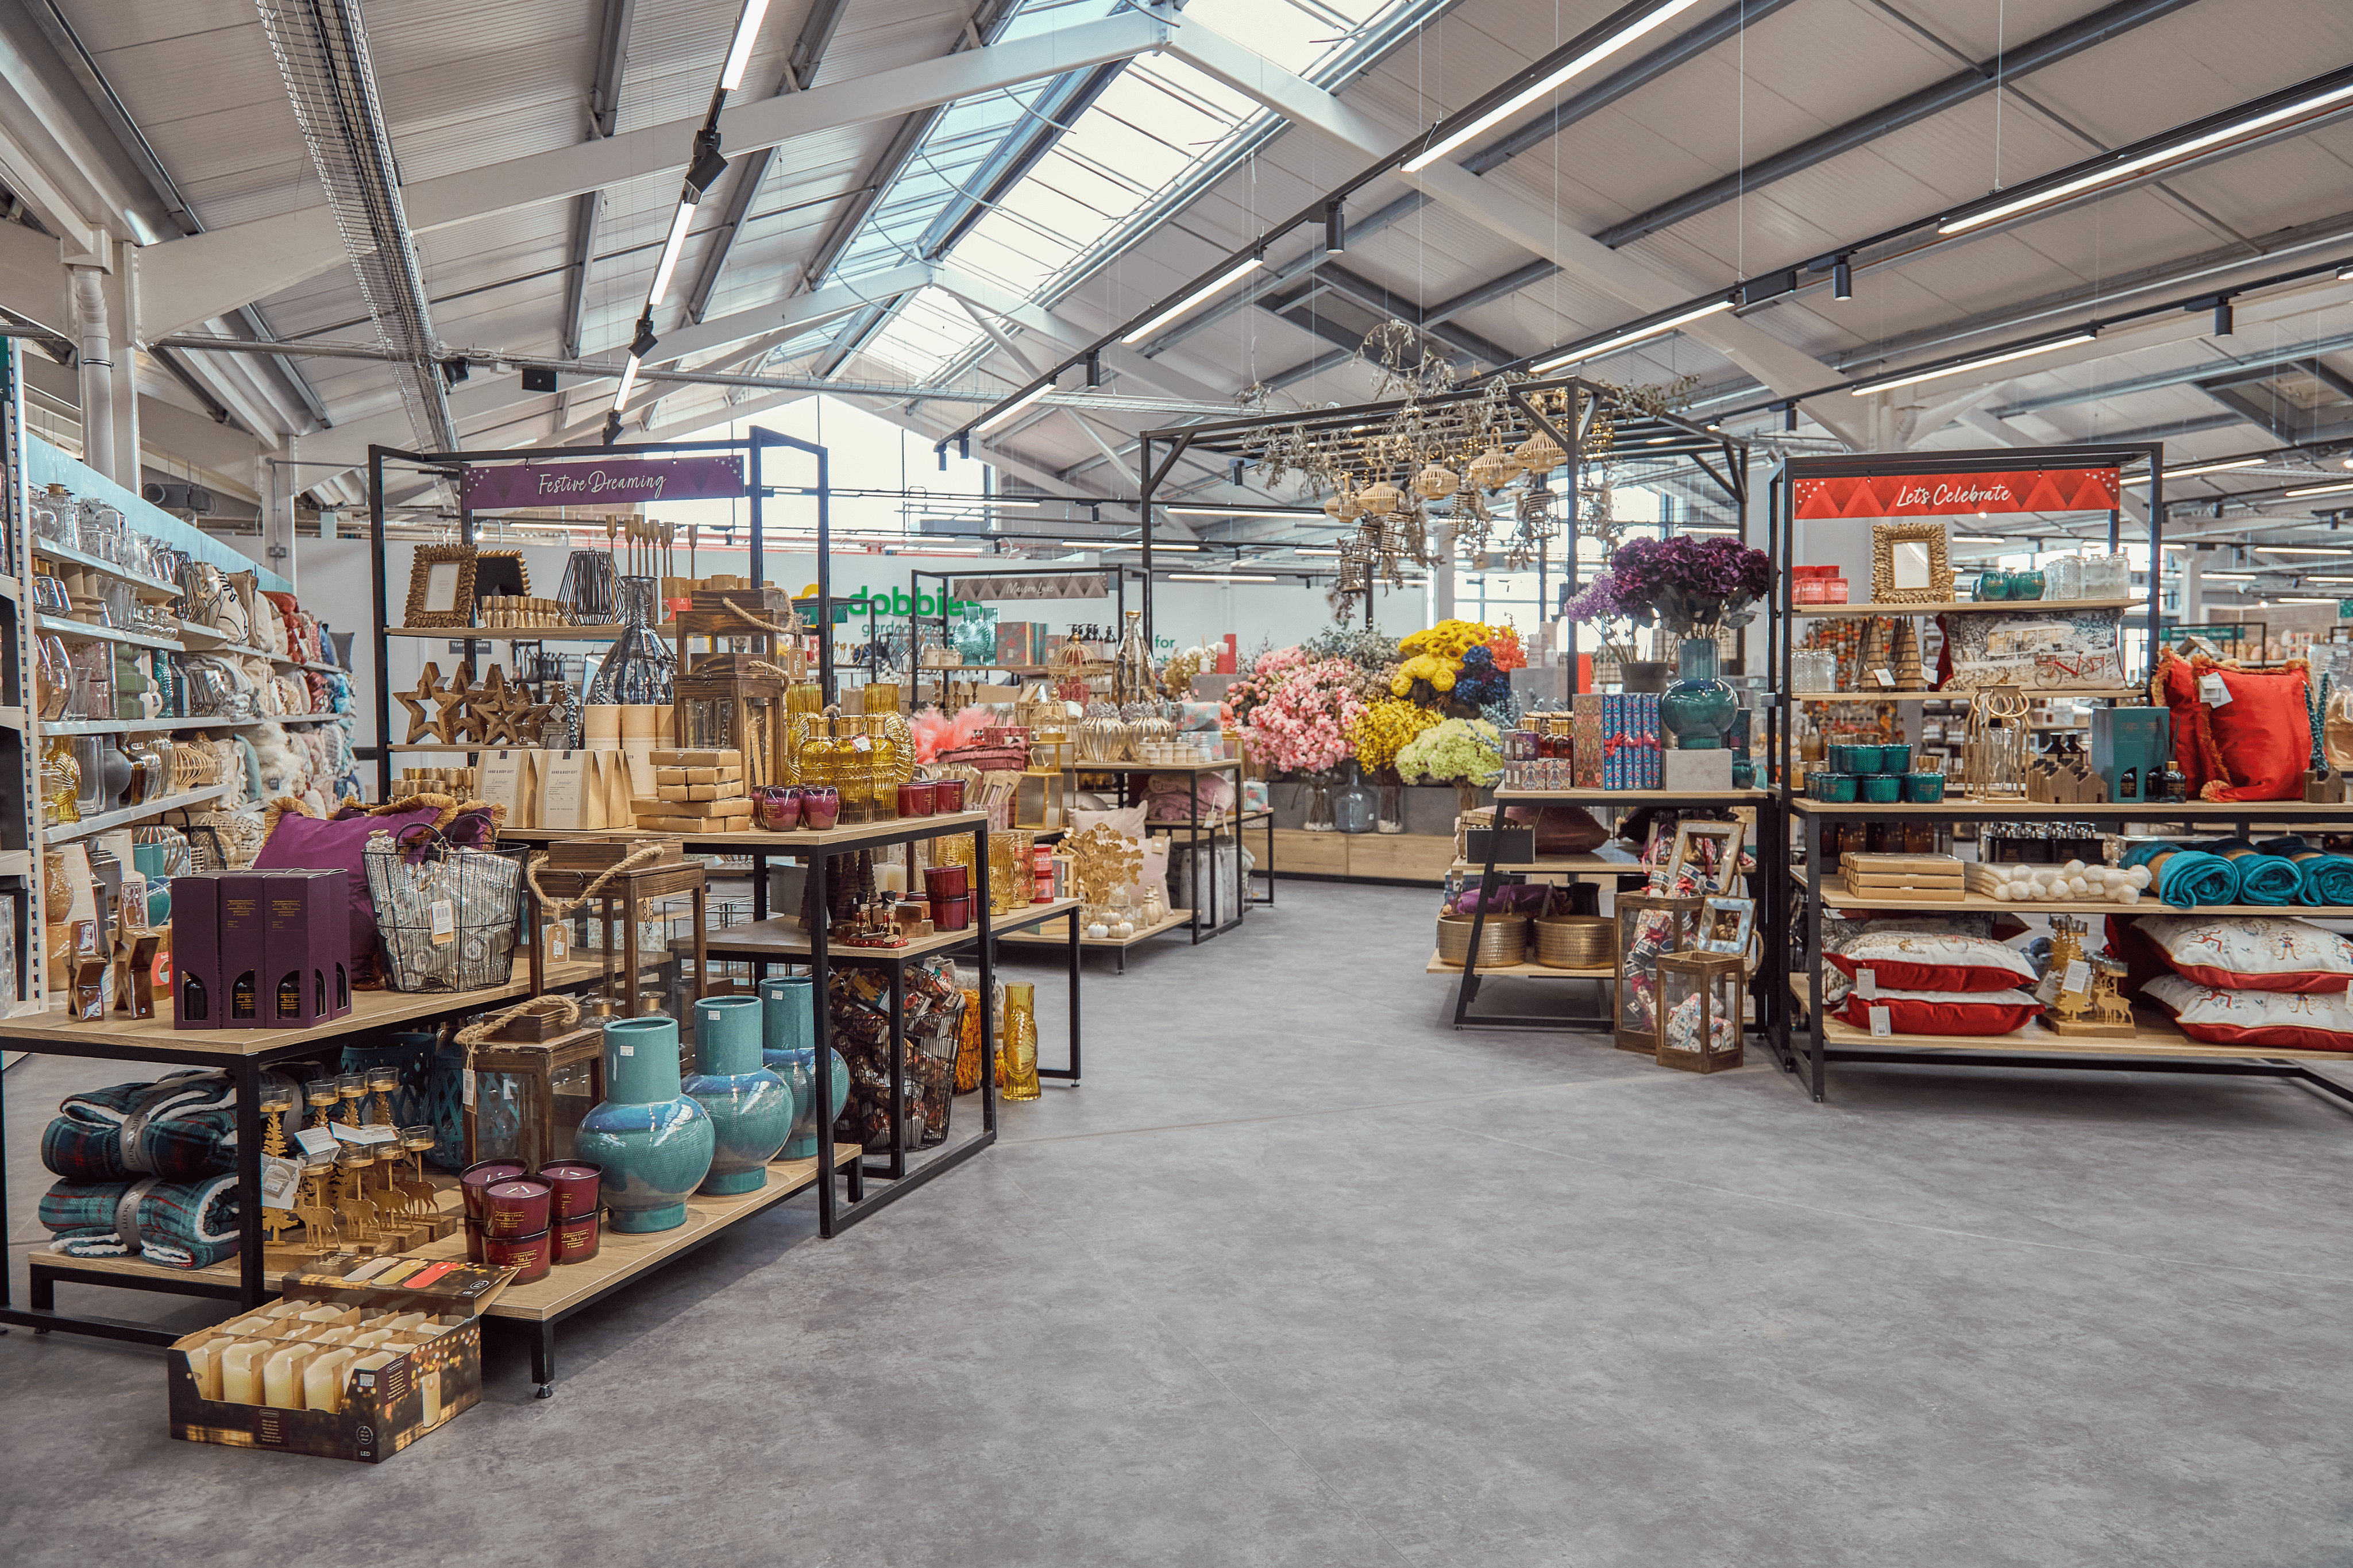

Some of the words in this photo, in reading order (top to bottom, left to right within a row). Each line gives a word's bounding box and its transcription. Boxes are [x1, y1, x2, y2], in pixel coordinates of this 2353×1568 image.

[539, 473, 587, 495] Festive
[588, 470, 667, 499] Dreaming
[1896, 485, 1931, 507] Let's
[1933, 484, 2012, 506] Celebrate
[1006, 582, 1036, 594] Maison
[1036, 581, 1054, 594] Luxe
[1155, 634, 1176, 648] for
[126, 1131, 136, 1142] &
[126, 1192, 139, 1202] &
